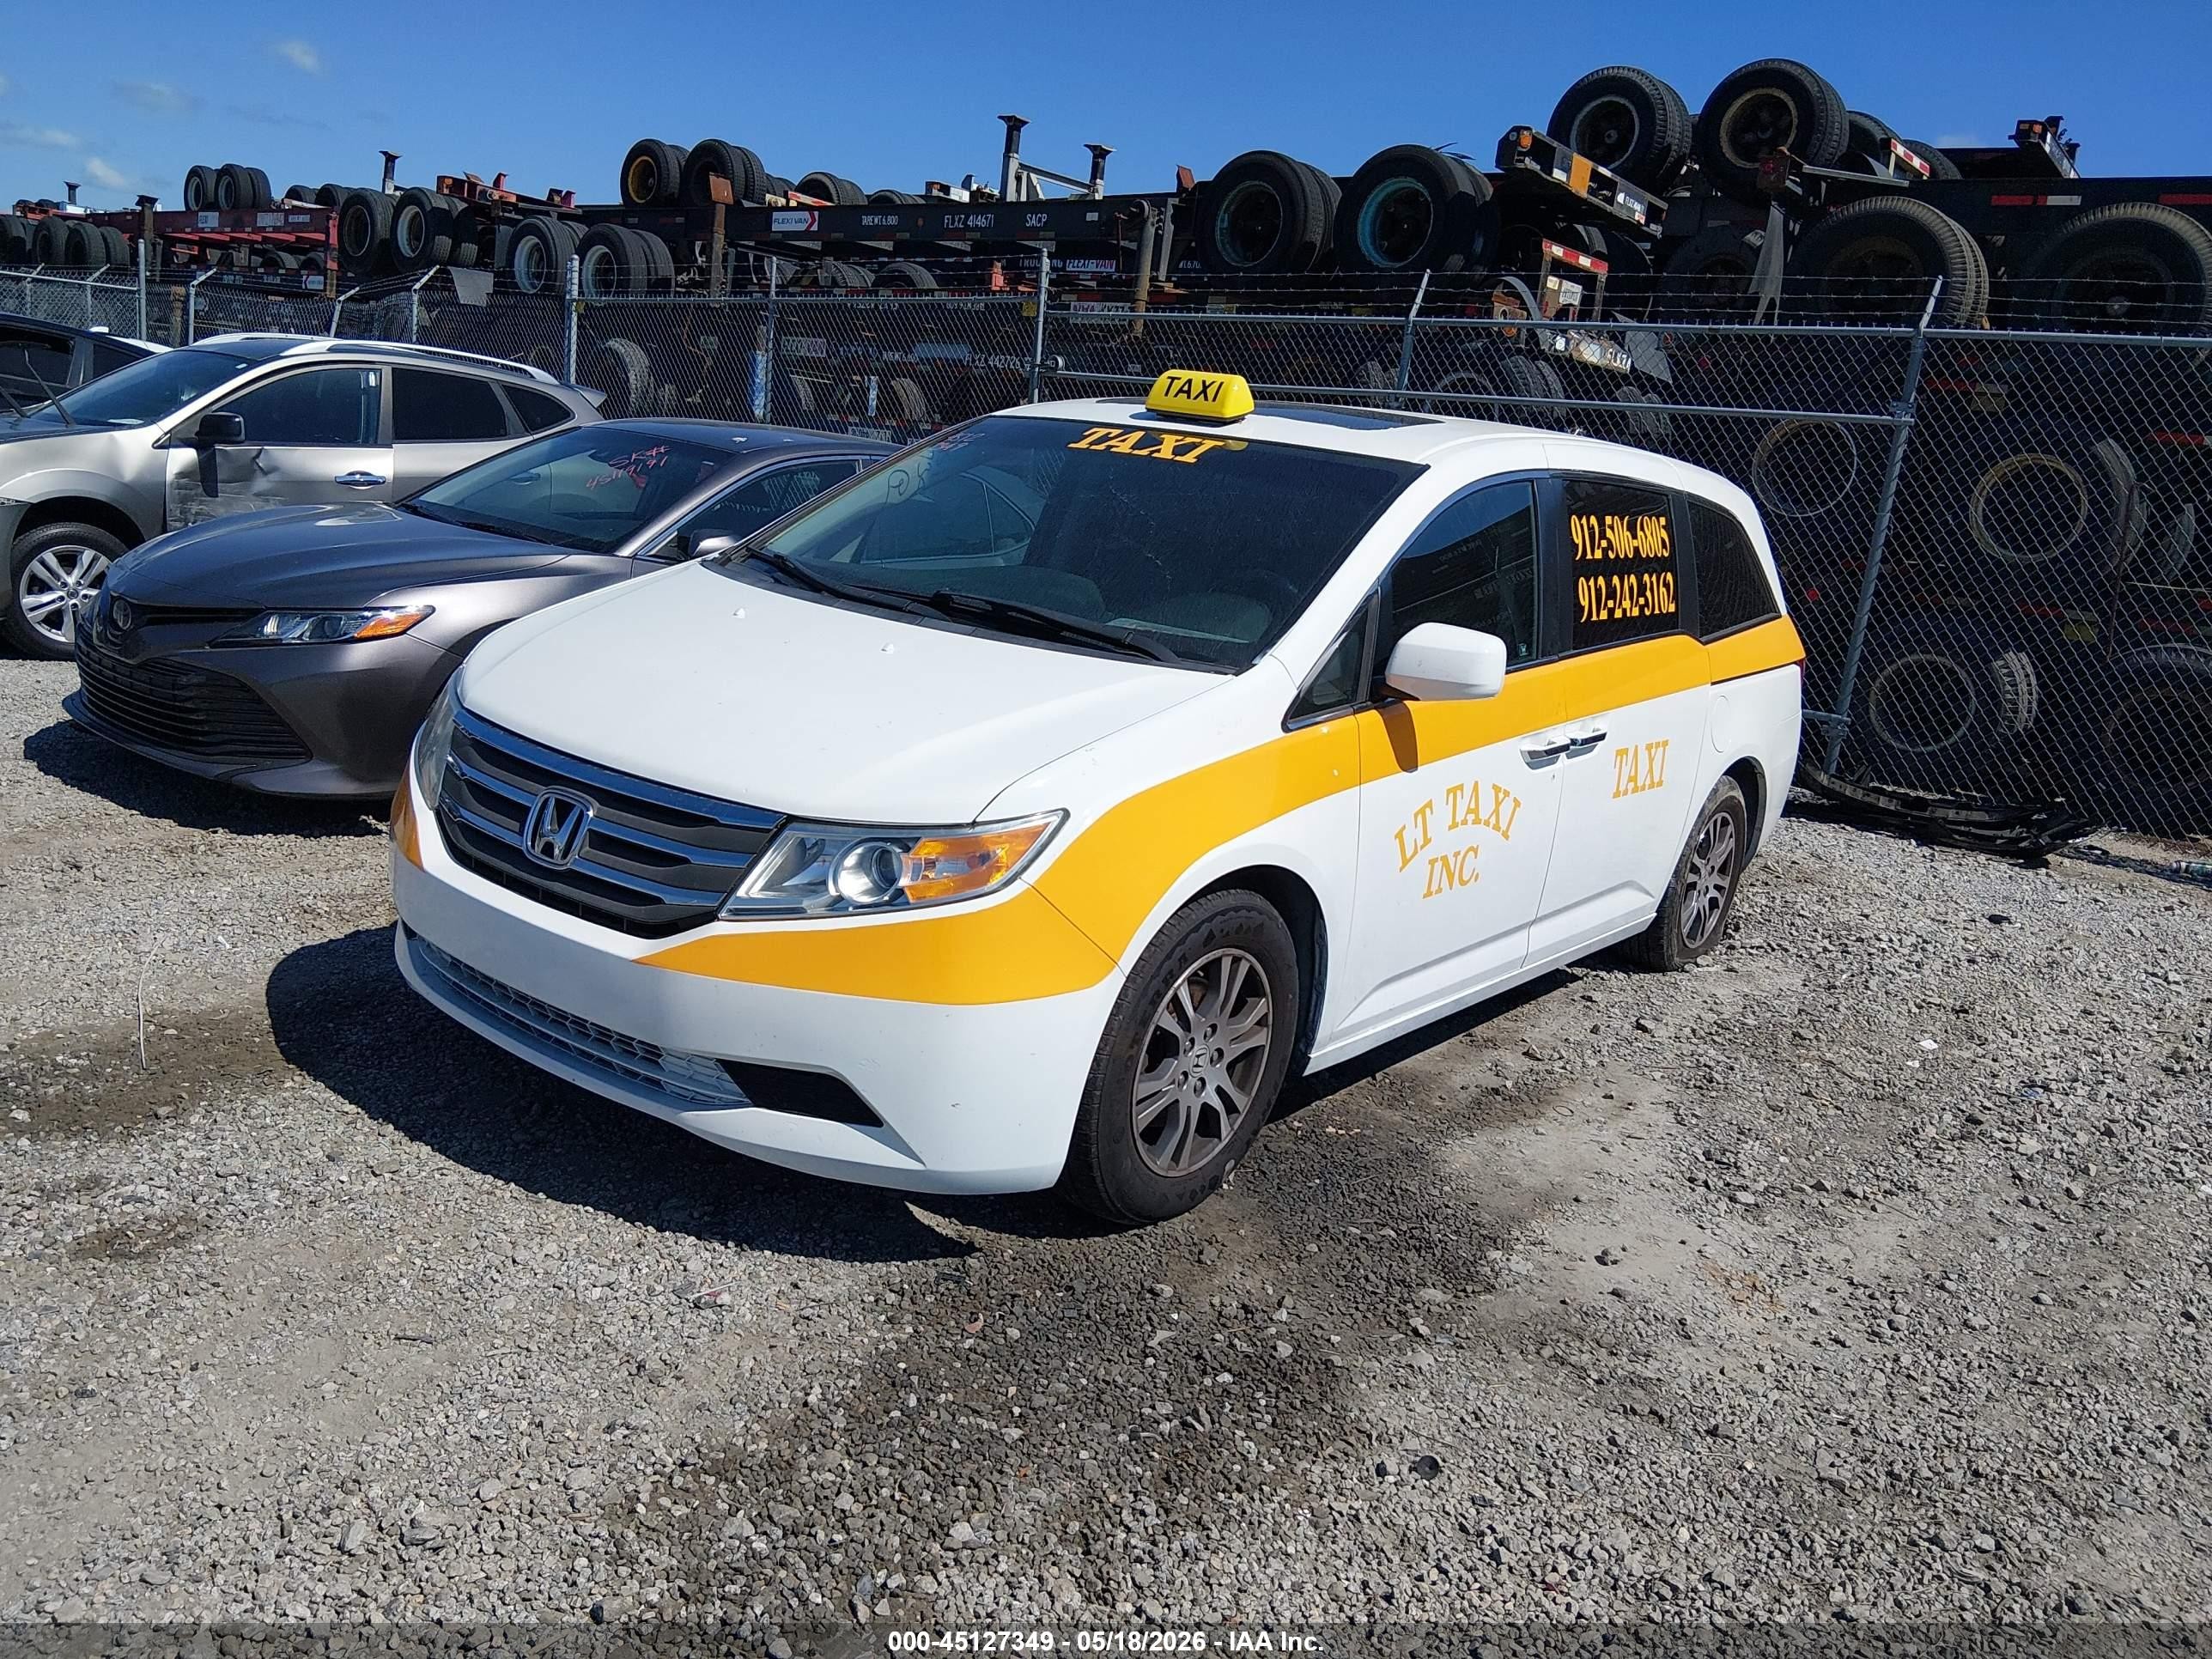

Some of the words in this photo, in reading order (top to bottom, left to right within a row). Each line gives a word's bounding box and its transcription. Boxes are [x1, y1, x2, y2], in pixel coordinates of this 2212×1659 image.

[874, 215, 883, 226] WT
[944, 215, 965, 228] FLXZ
[967, 214, 994, 228] 414671
[1025, 213, 1048, 228] SACP
[1164, 375, 1225, 403] TAXI
[1067, 426, 1226, 464] TAXI
[1571, 514, 1670, 561] 912-506-6805
[1577, 571, 1676, 623] 912-242-3162
[1611, 738, 1669, 799] TAXI
[1394, 798, 1434, 873] LT
[1445, 780, 1522, 842] TAXI
[1422, 844, 1480, 900] INC.
